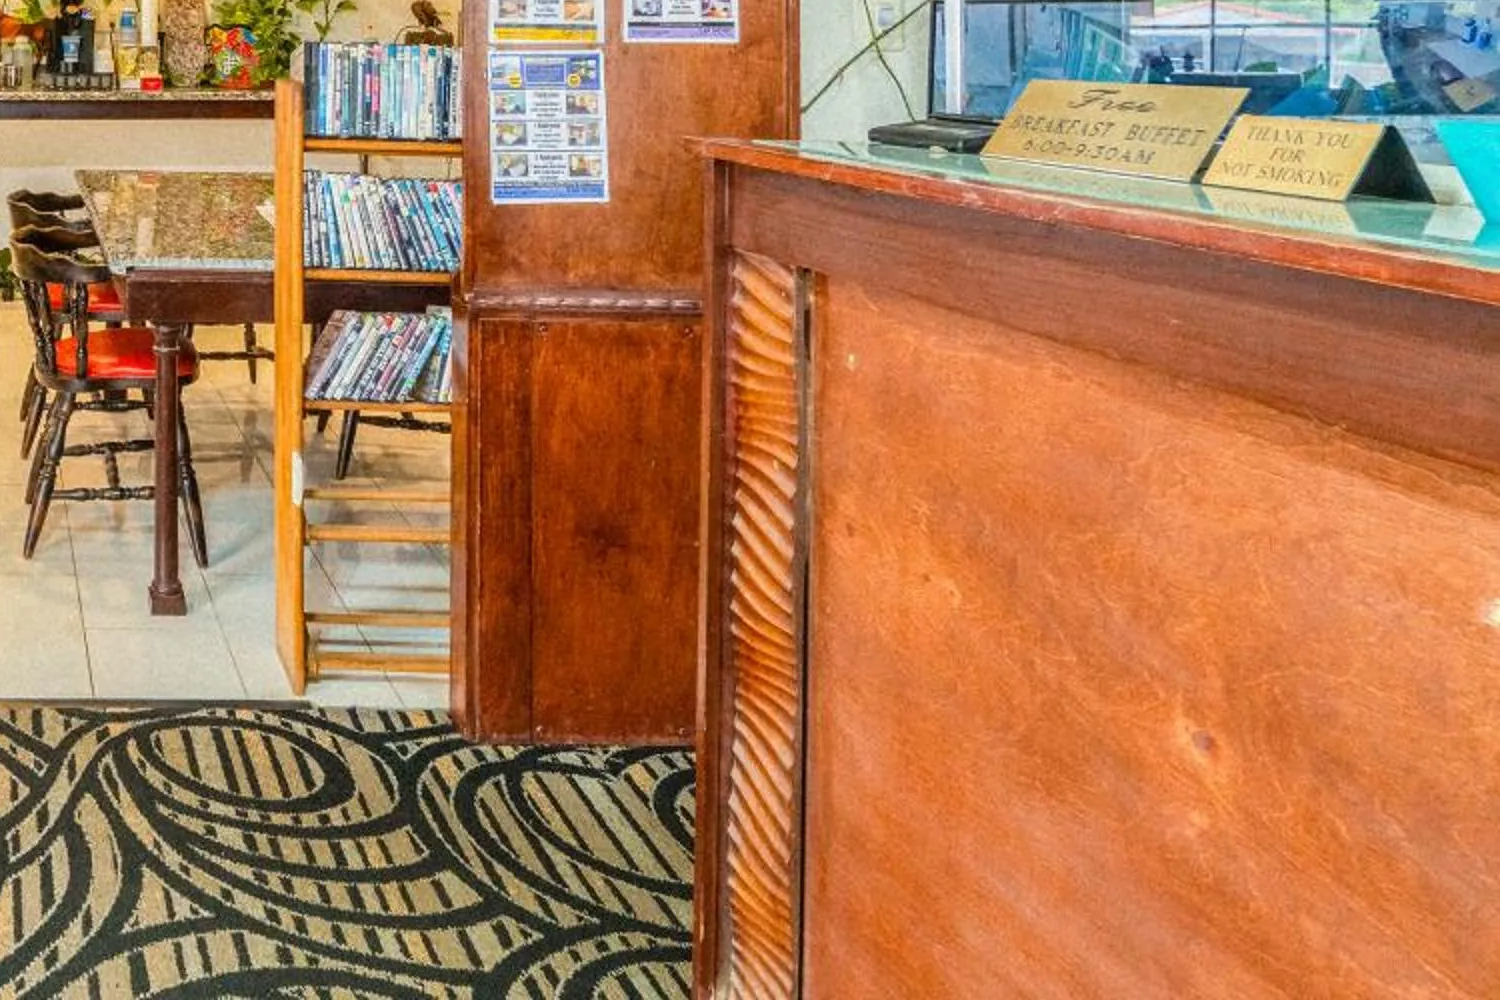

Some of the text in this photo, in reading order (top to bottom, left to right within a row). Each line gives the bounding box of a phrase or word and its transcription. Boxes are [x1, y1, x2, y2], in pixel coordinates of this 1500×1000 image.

[1065, 88, 1159, 113] Free
[1009, 113, 1206, 147] BREAKFAST BUFFET
[1246, 125, 1354, 149] THANK YOU
[1267, 147, 1308, 163] FOR
[1220, 161, 1347, 188] NOT SMOKING
